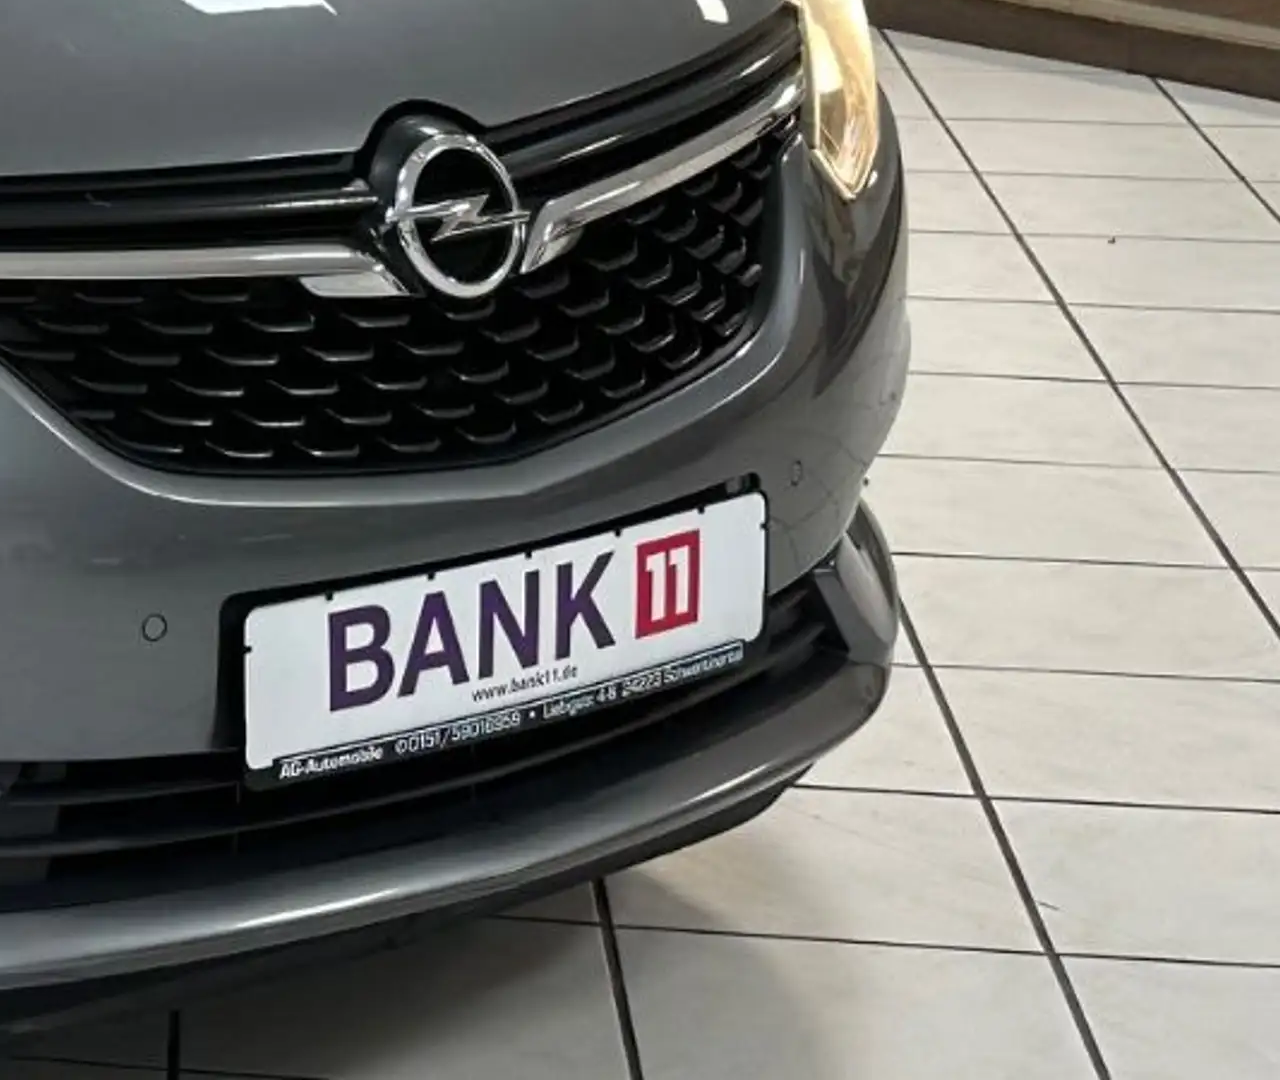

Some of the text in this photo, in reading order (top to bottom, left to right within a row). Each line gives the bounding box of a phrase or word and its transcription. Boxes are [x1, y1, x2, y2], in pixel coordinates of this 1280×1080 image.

[326, 539, 692, 713] BANK 11
[471, 665, 579, 703] www.bank11.de
